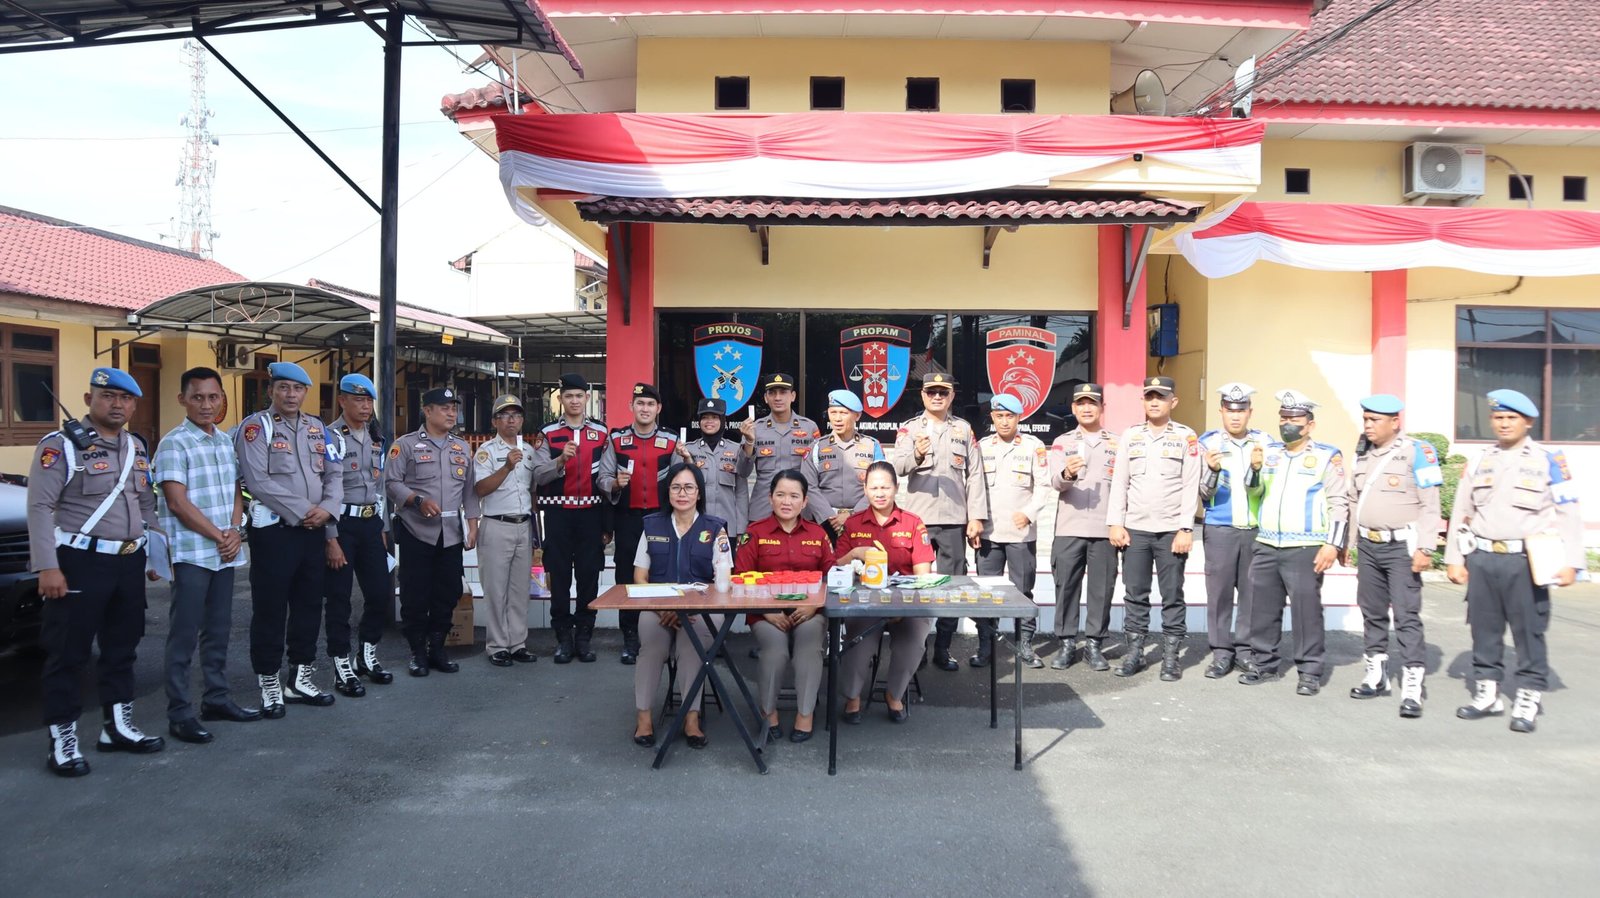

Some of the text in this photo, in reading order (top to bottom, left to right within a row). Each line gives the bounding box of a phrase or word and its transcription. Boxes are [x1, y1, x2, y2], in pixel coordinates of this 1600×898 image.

[708, 325, 752, 336] PROVOS
[853, 327, 899, 337] PROPAM
[999, 328, 1046, 340] PAMINAL
[1031, 423, 1051, 433] EFEKTIF
[82, 450, 109, 461] DONI
[891, 531, 913, 539] POLRI
